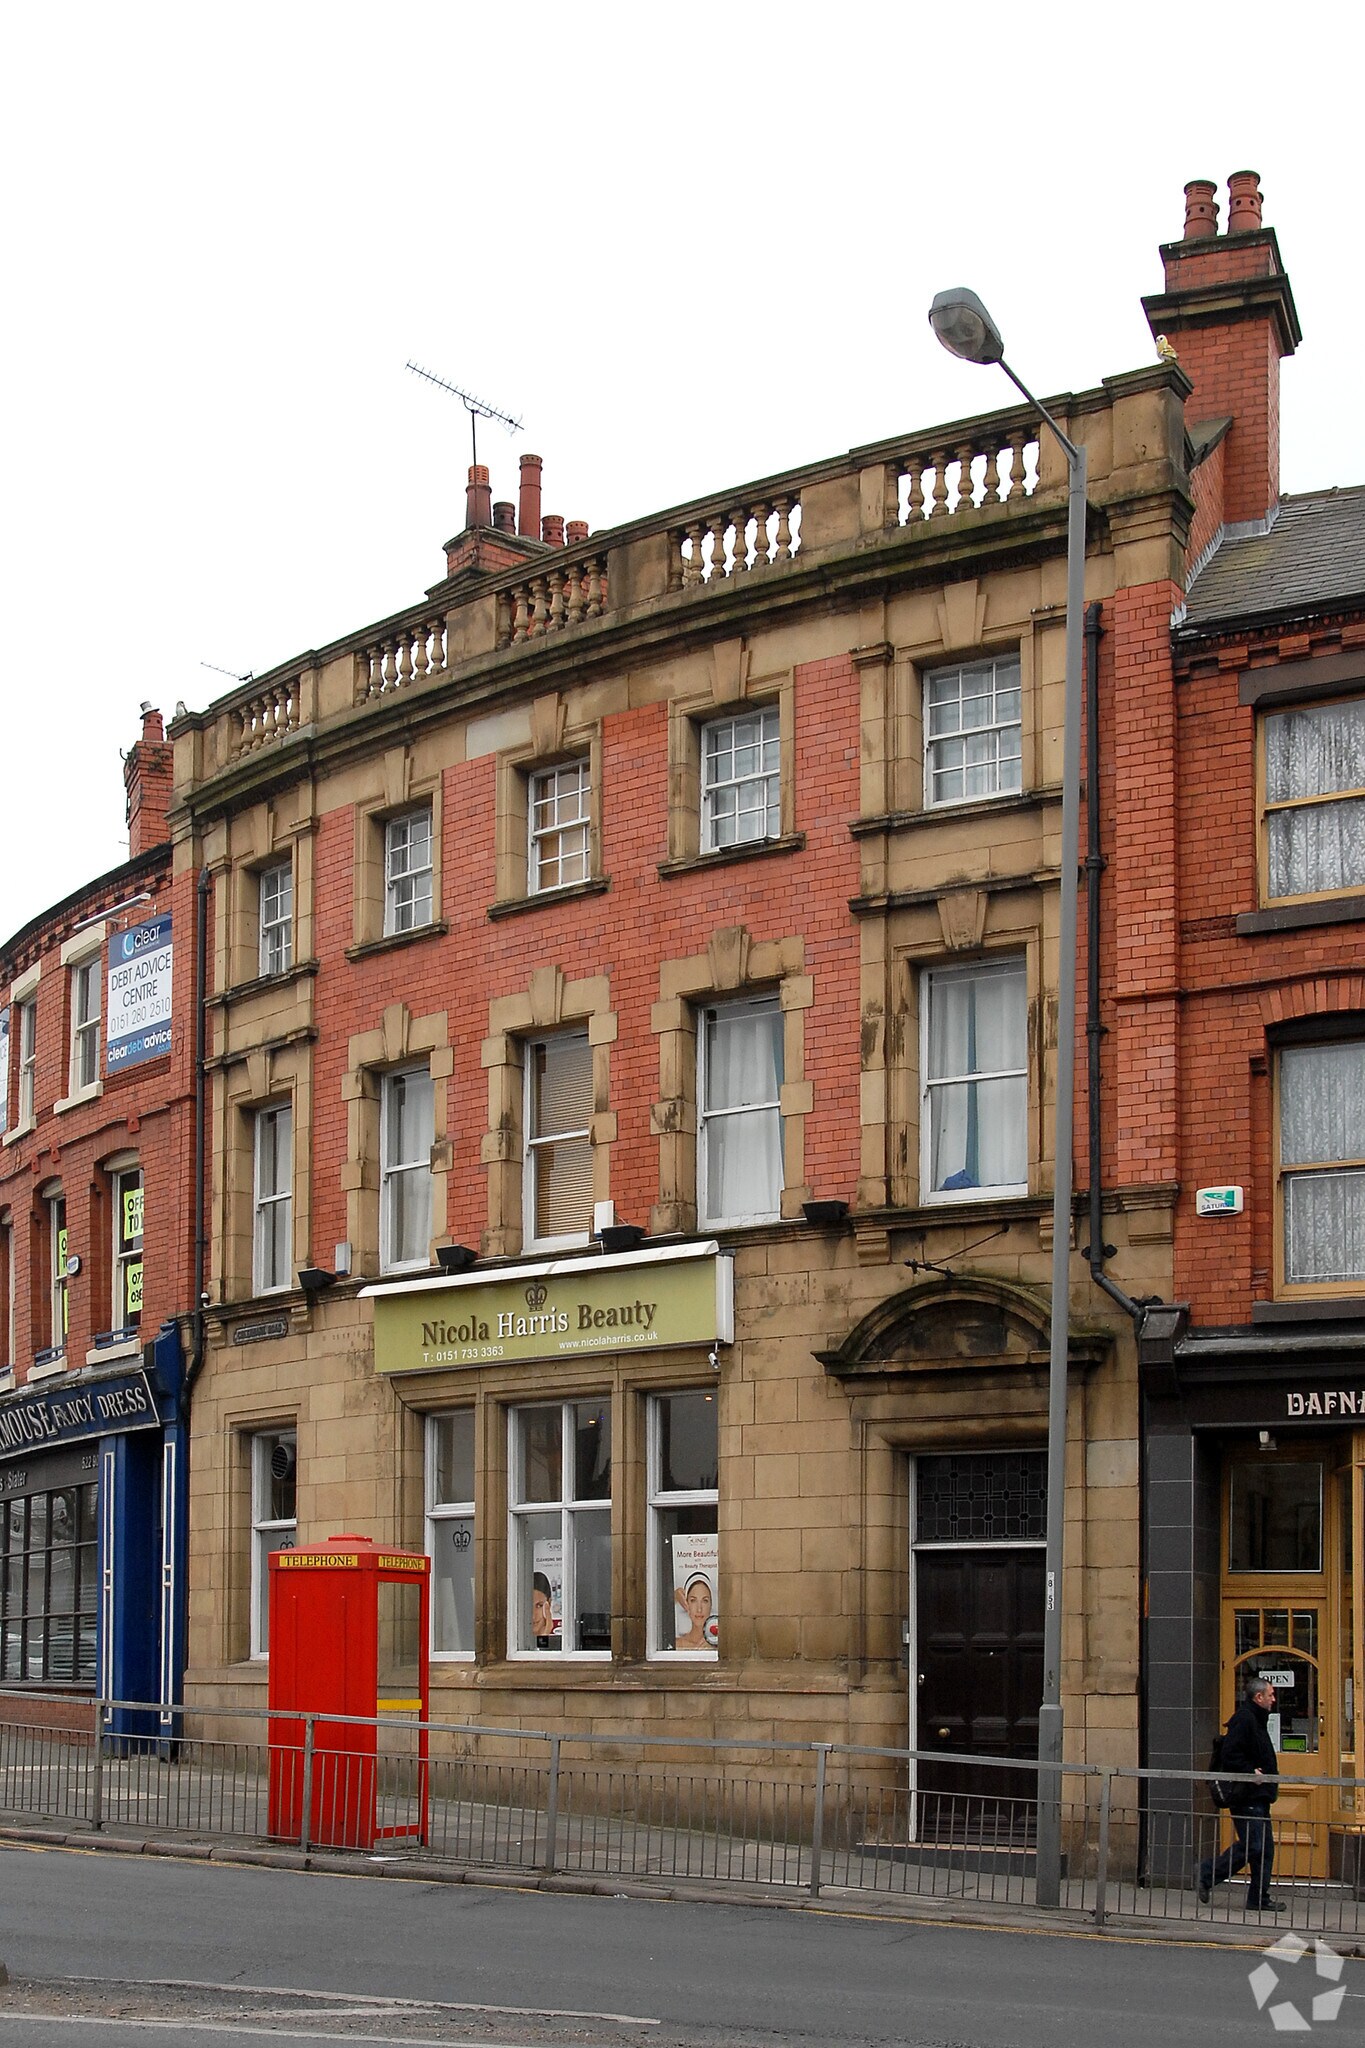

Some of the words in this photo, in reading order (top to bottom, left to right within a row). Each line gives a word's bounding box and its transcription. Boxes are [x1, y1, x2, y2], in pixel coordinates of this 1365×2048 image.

[134, 925, 161, 947] clear
[111, 967, 133, 991] DEBT
[134, 952, 171, 981] ADVICE
[122, 979, 158, 1008] CENTRE
[110, 1013, 129, 1033] 0151
[131, 1005, 147, 1026] 280
[149, 996, 171, 1018] 2510
[107, 1027, 172, 1063] cleardebtadvice
[421, 1314, 490, 1347] Nicola
[496, 1306, 569, 1338] Harris
[576, 1299, 657, 1331] Beauty
[558, 1331, 658, 1350] www.nicolaharris.co.uk
[436, 1350, 458, 1362] 0151
[461, 1348, 478, 1361] 733
[481, 1345, 504, 1358] 3363
[50, 1394, 96, 1428] FANCY
[96, 1386, 147, 1419] DRESS
[7, 1470, 27, 1490] Slater
[284, 1555, 354, 1567] TELEPHONE
[381, 1556, 423, 1570] TELEPHONE
[1262, 1675, 1289, 1684] OPEN
